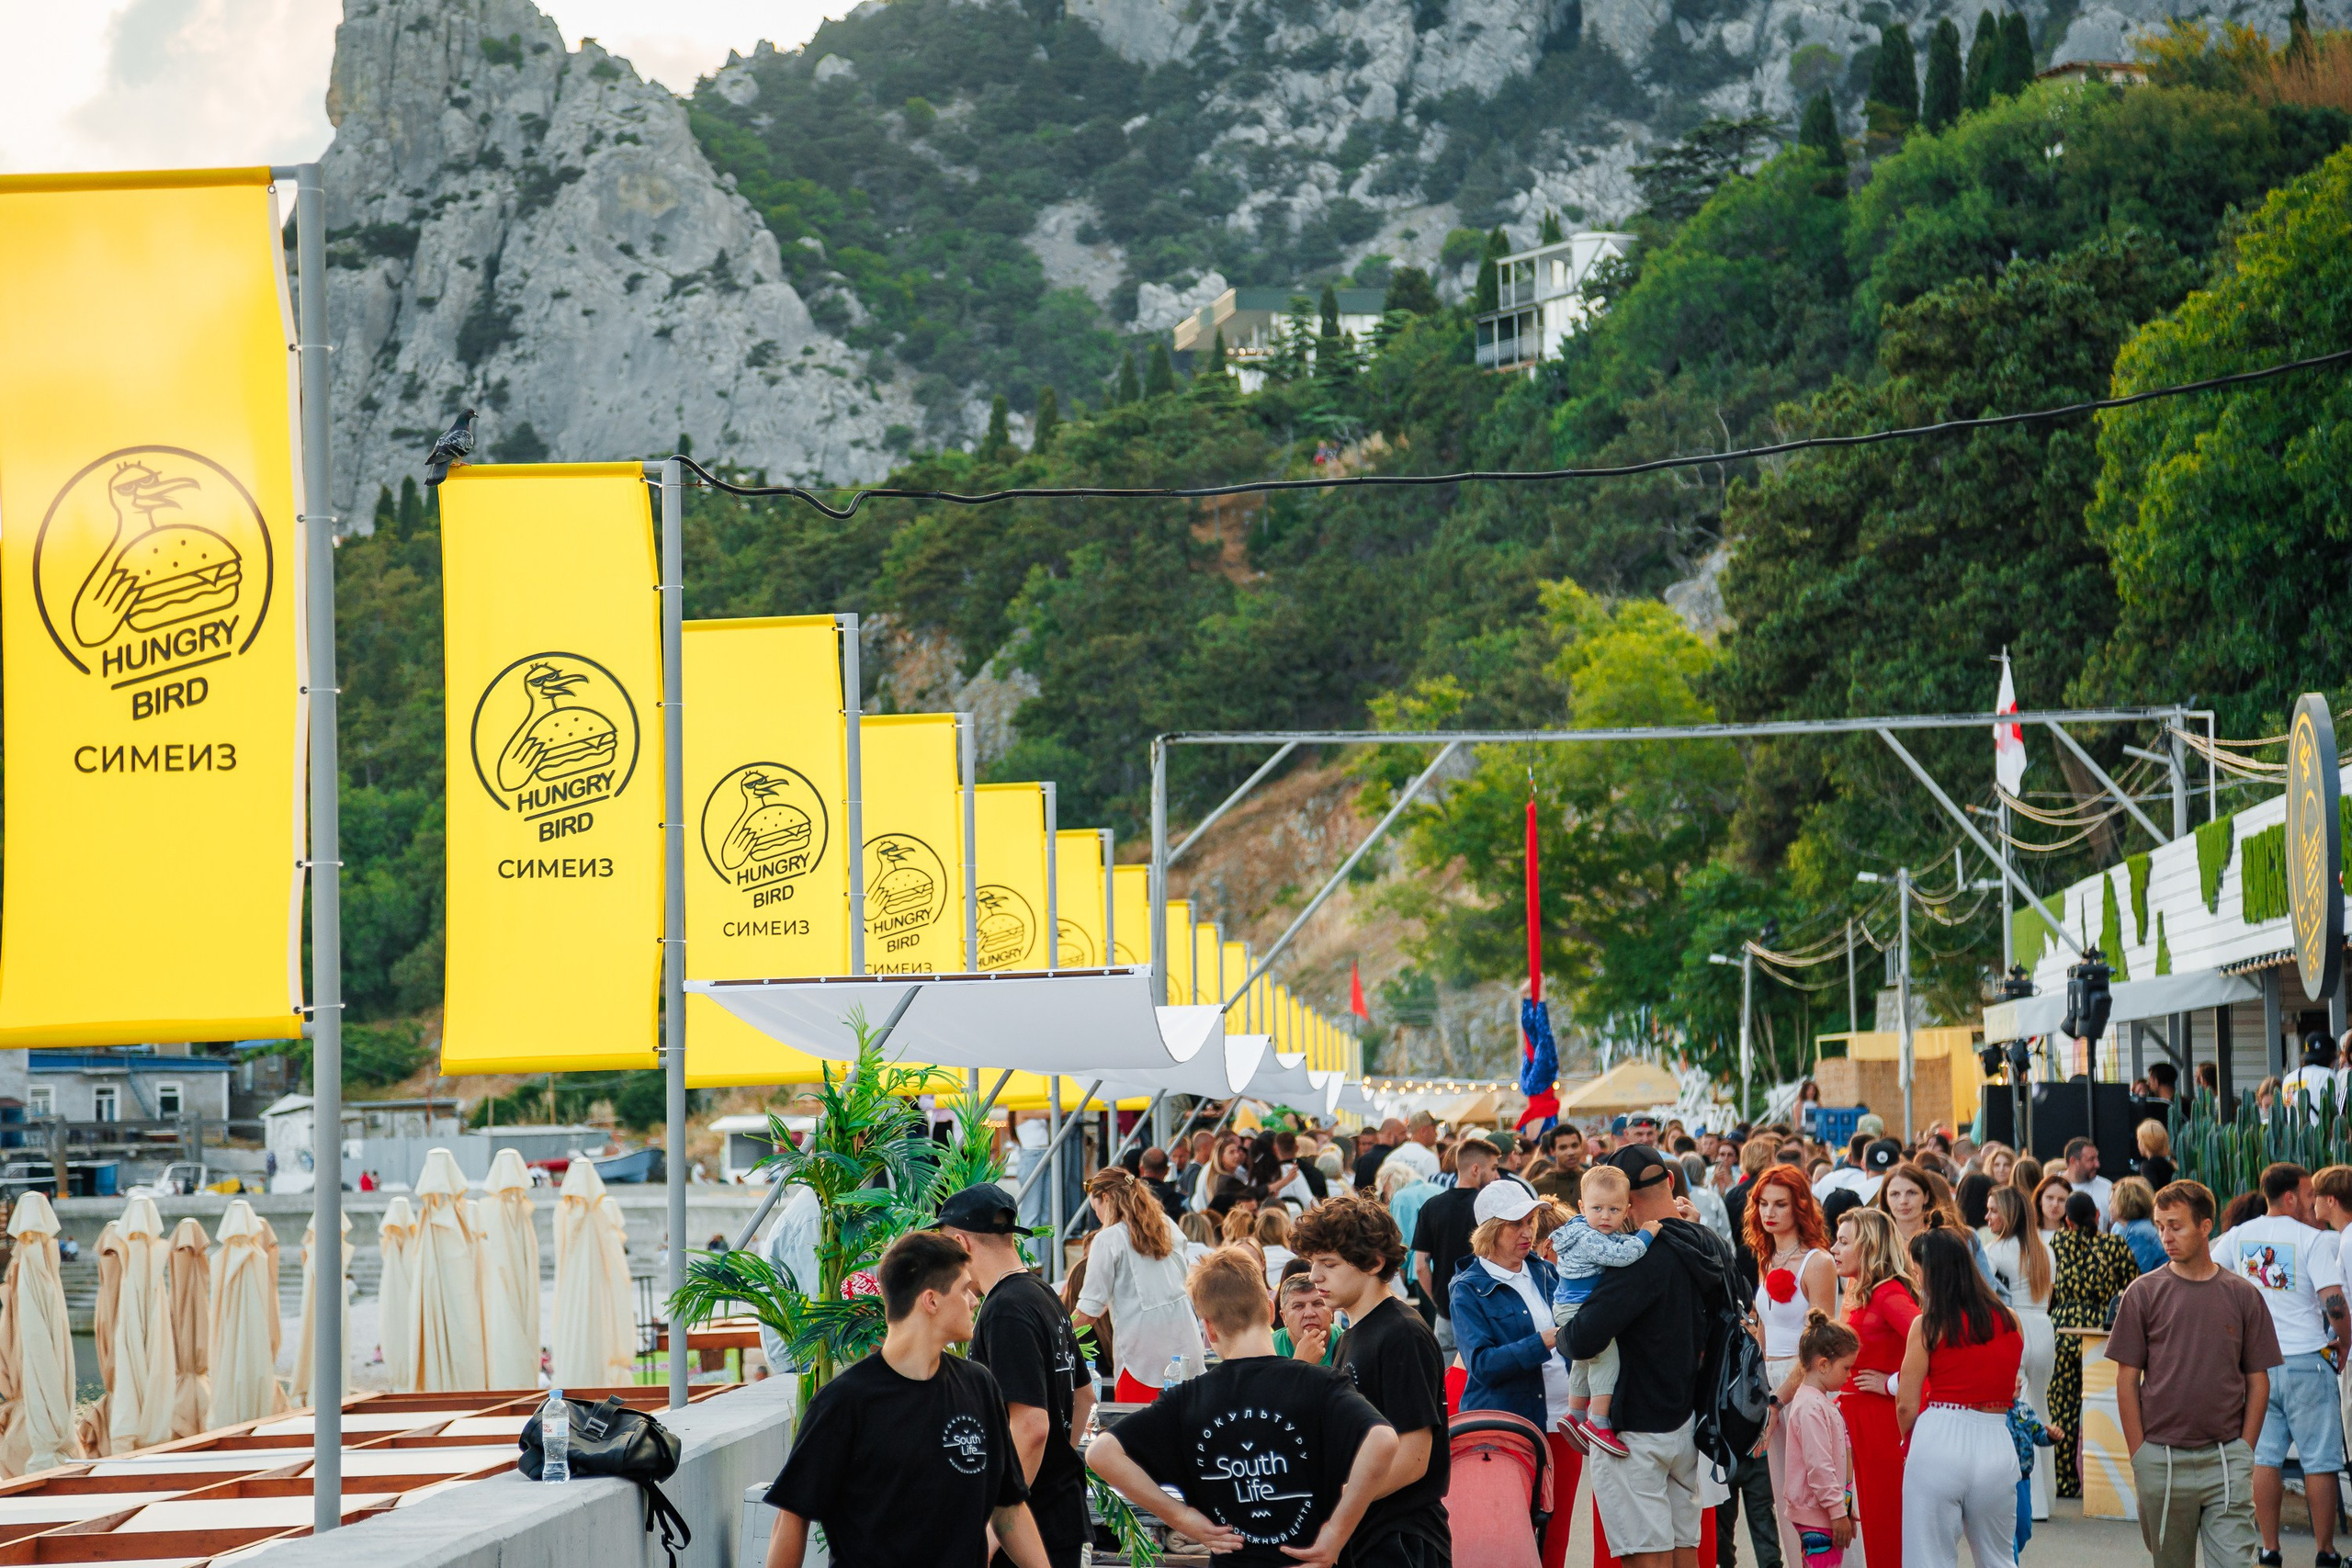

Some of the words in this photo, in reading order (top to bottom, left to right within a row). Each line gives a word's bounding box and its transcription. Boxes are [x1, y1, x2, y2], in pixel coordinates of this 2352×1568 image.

[102, 615, 240, 678] HUNGRY
[132, 677, 209, 721] BIRD
[74, 743, 237, 773] СИМЕИЗ
[517, 769, 616, 813] HUNGRY
[538, 812, 594, 842] BIRD
[497, 858, 615, 879] СИМЕИЗ
[736, 852, 811, 886] HUNGRY
[753, 885, 795, 908] BIRD
[722, 919, 810, 937] СИМЕИЗ
[874, 907, 933, 934] HUNGRY
[887, 933, 920, 953] BIRD
[865, 962, 933, 976] СИМЕИЗ
[944, 1434, 981, 1448] South
[961, 1444, 987, 1456] Life
[1201, 1451, 1288, 1480] South
[1234, 1479, 1314, 1504] Life
